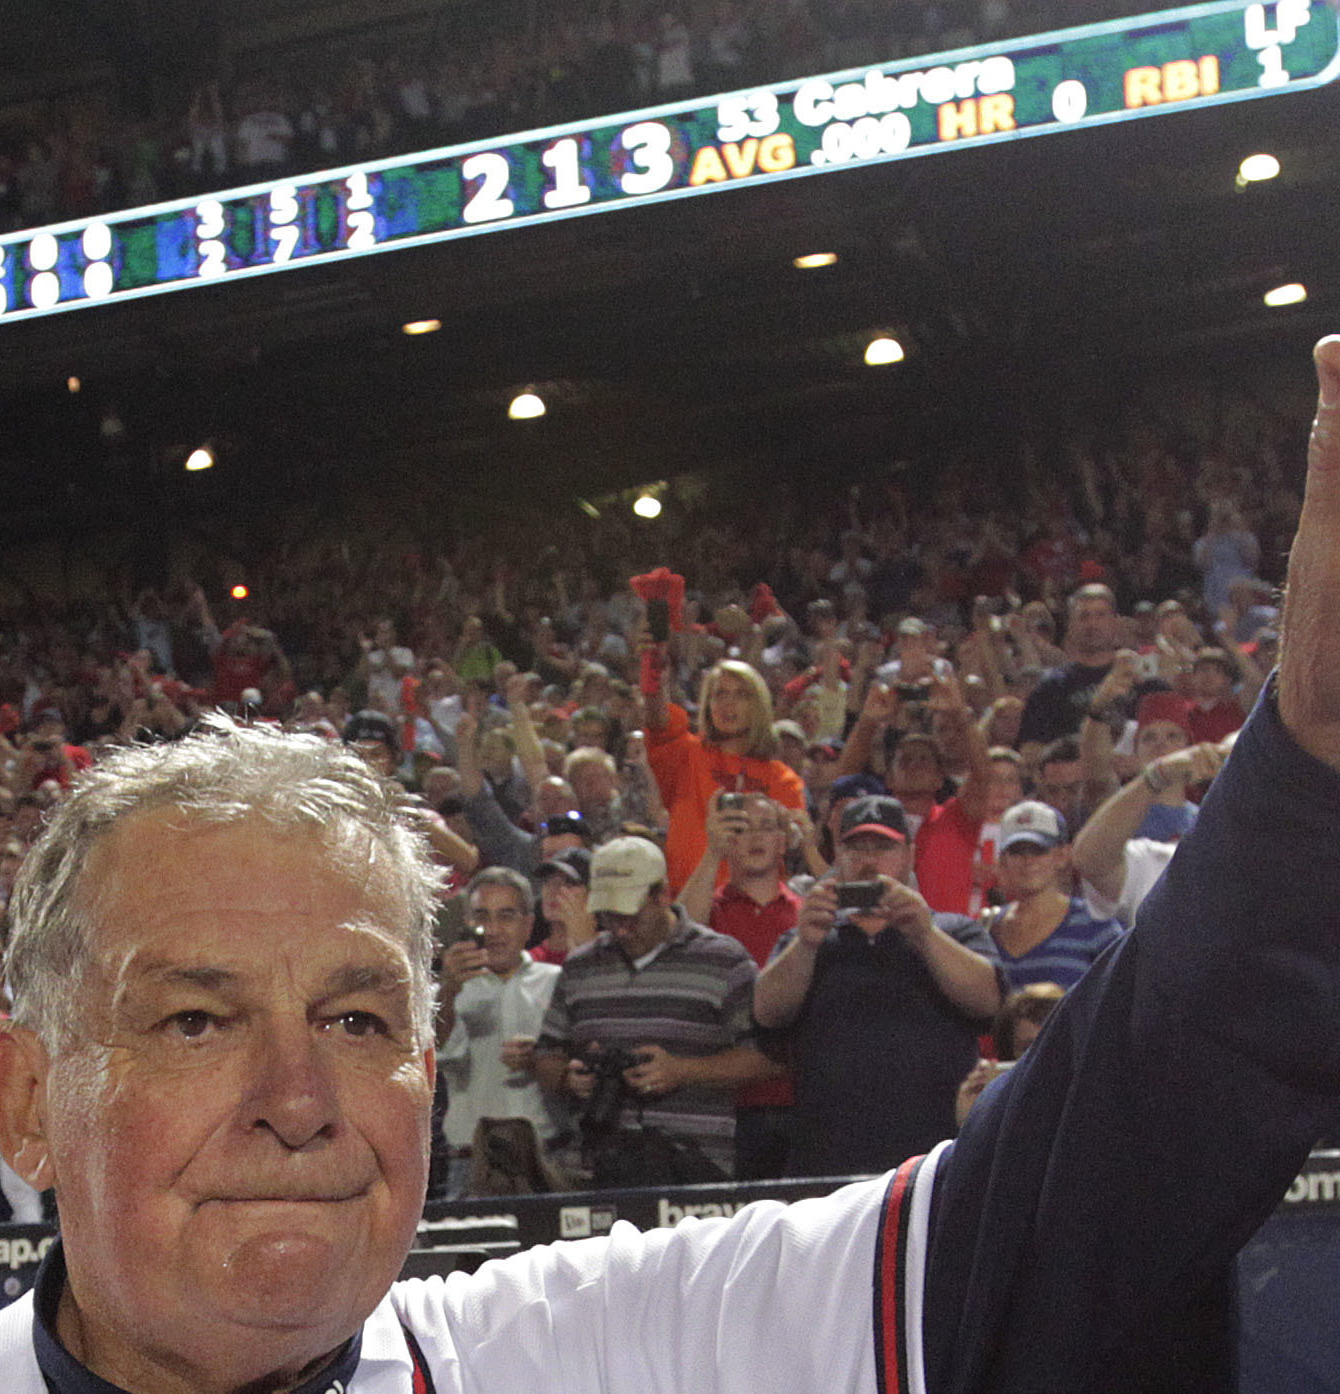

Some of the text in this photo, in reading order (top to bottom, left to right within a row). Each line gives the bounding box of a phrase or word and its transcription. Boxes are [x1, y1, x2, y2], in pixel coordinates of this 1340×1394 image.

[689, 133, 796, 187] AVG
[938, 93, 1016, 141] HR
[1052, 79, 1087, 124] 0
[1124, 55, 1220, 109] RBI
[1258, 44, 1289, 86] 1
[717, 91, 780, 142] 53
[793, 56, 1015, 126] Cabrera
[463, 122, 673, 223] 2 1 3
